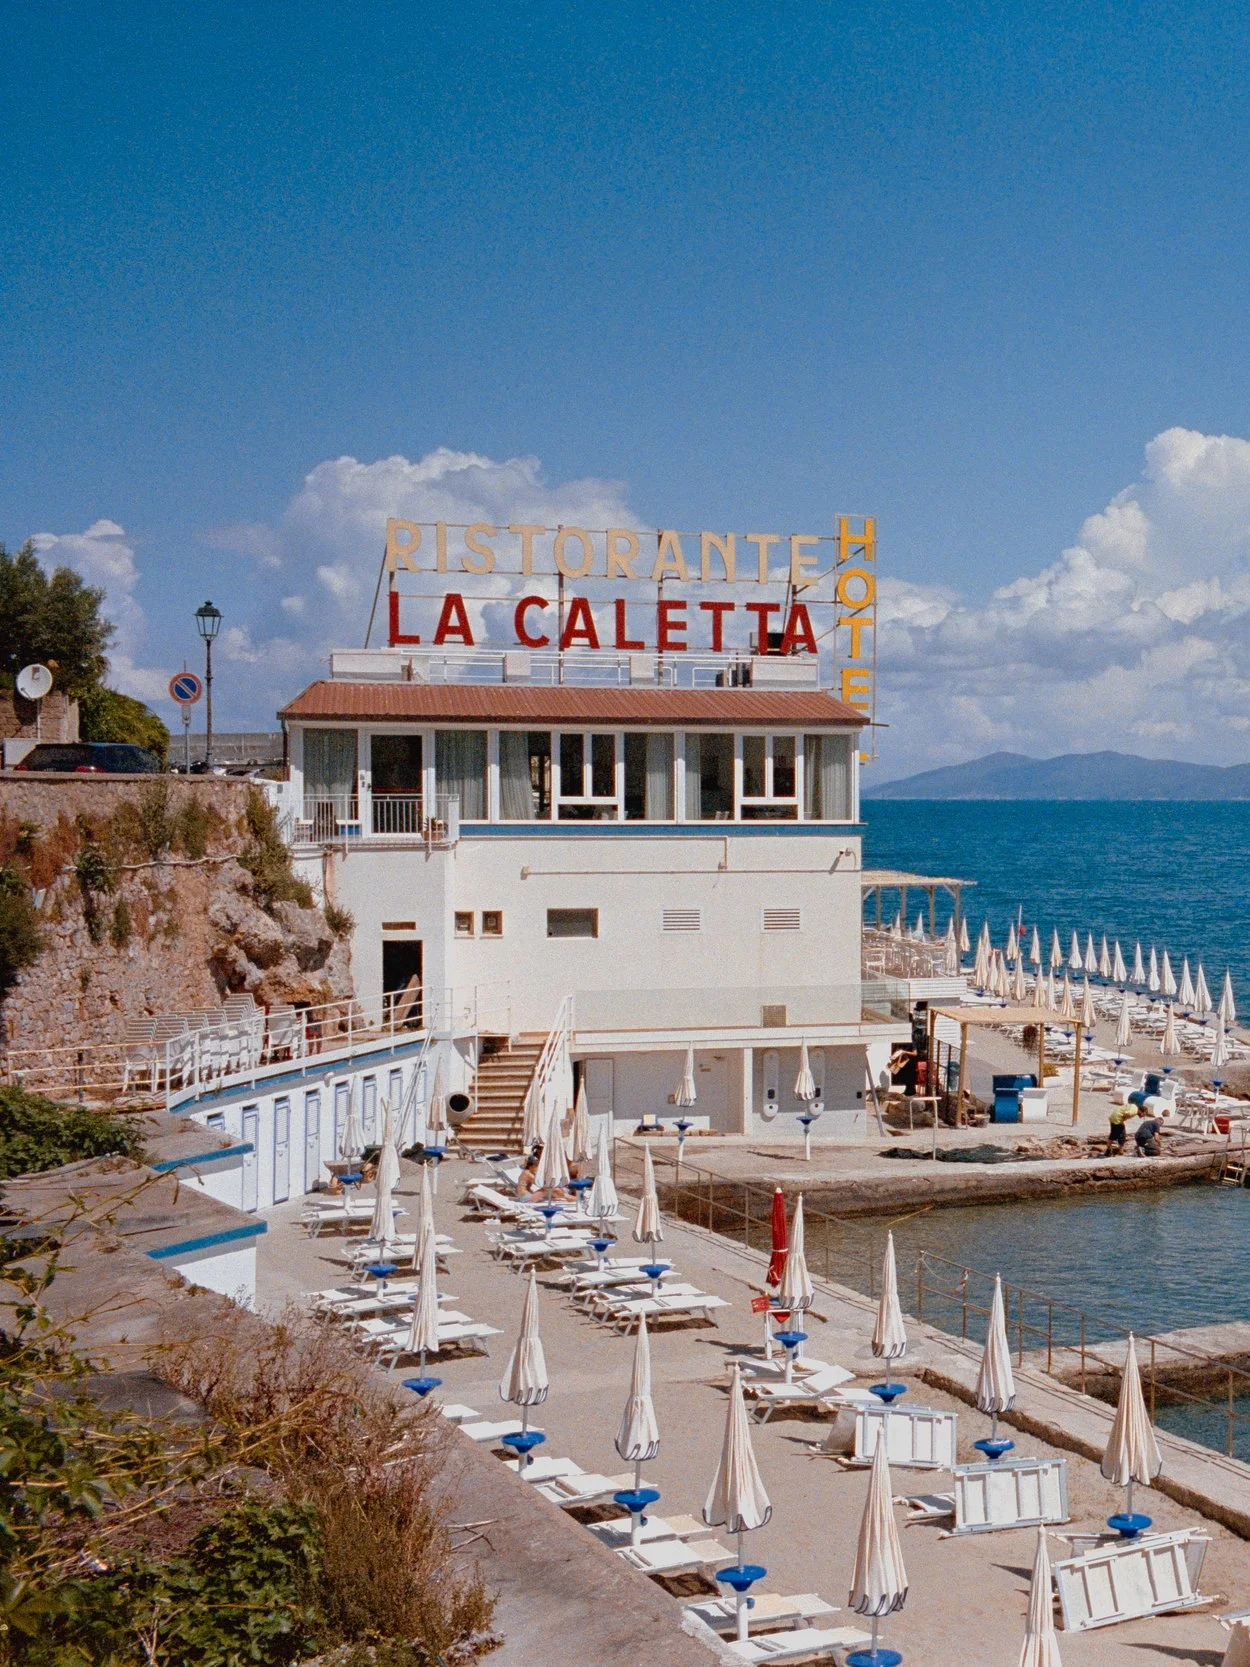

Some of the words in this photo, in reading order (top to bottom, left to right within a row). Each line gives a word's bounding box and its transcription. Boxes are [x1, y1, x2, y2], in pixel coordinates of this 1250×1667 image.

[386, 518, 818, 586] RISTORANTE
[389, 591, 475, 647] LA
[514, 595, 819, 656] CALETTA
[837, 516, 876, 761] HOTE
